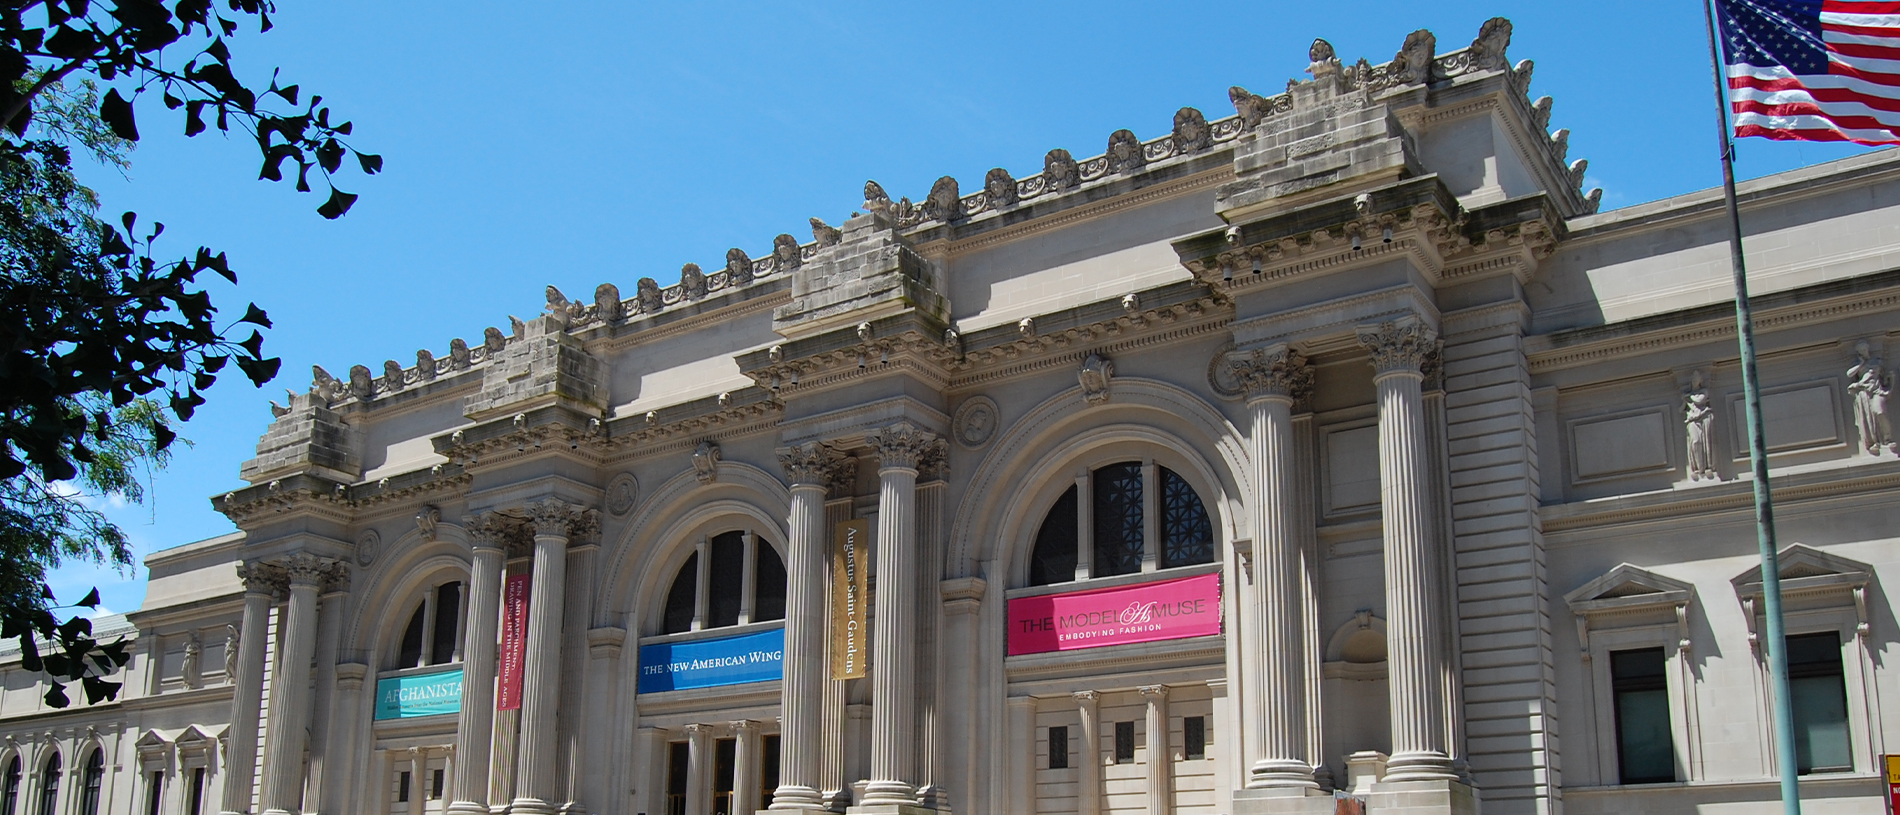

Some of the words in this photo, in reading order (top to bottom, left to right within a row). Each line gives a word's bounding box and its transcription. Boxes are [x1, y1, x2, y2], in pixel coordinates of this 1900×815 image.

[843, 527, 857, 582] Augustus
[507, 582, 515, 620] DRAWING
[1019, 616, 1054, 633] THE
[1060, 609, 1121, 629] MODEL
[1120, 601, 1157, 625] As
[1151, 599, 1205, 618] MUSE
[506, 621, 513, 632] IN
[846, 585, 858, 674] Saint-Gaudens
[1059, 628, 1115, 641] EMBODYING
[1120, 624, 1161, 635] FASHION
[503, 652, 511, 684] MIDDLE
[644, 665, 663, 675] THE
[667, 661, 689, 672] NEW
[691, 655, 746, 670] AMERICAN
[749, 650, 782, 663] WING
